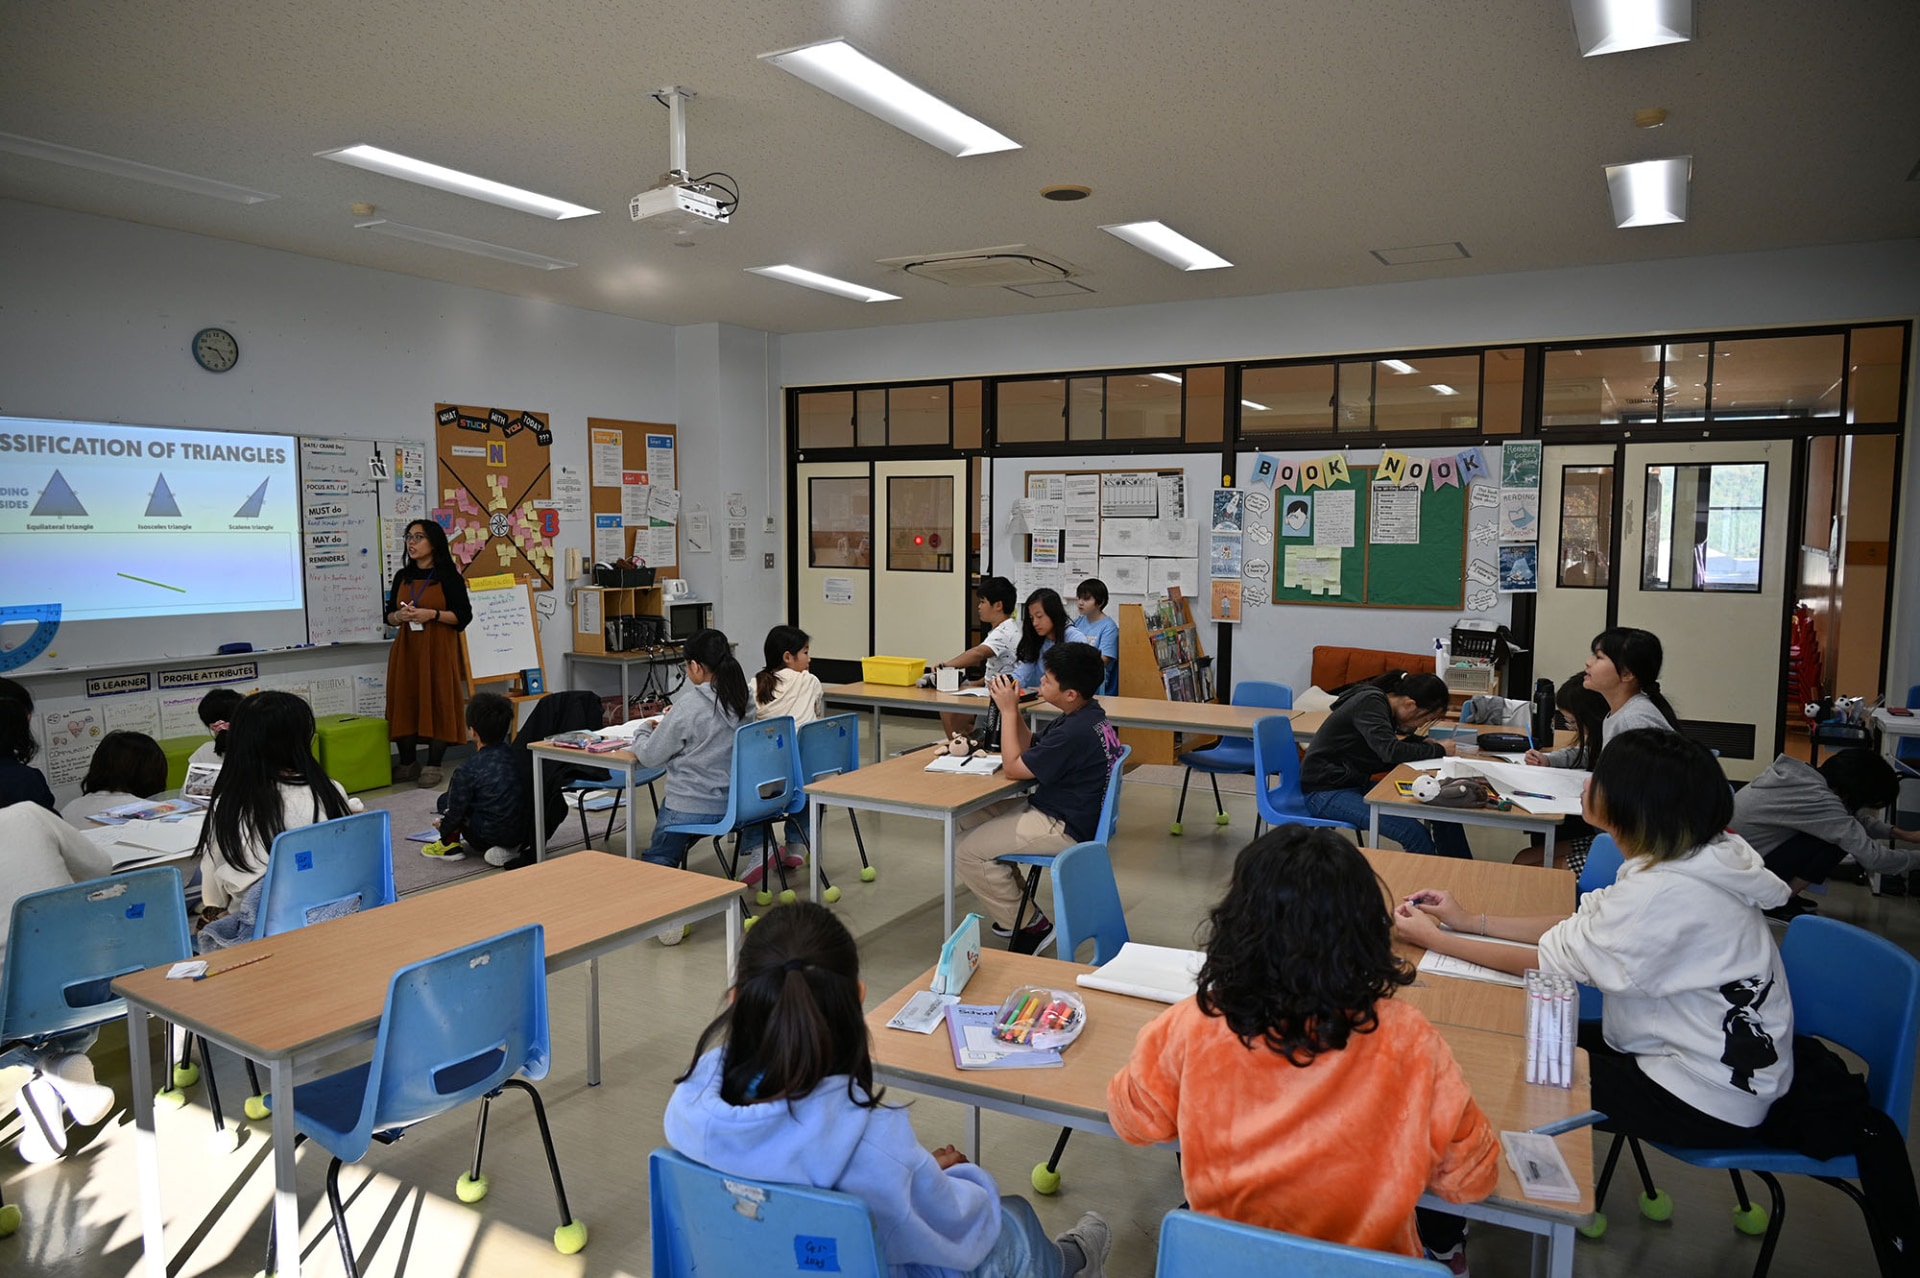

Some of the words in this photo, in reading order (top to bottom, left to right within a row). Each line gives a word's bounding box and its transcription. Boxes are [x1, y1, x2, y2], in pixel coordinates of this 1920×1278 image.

[439, 410, 456, 422] WHAT
[460, 418, 488, 430] STUCK
[490, 412, 506, 425] WITH
[505, 422, 521, 435] YOU
[523, 415, 542, 432] TODAY
[147, 440, 176, 459] OF
[180, 442, 286, 464] TRIANGLES
[490, 444, 504, 464] N
[370, 463, 387, 477] N
[1259, 460, 1342, 480] BOOK
[1385, 455, 1479, 478] NOOK
[0, 501, 29, 509] SIDES
[308, 507, 330, 516] MUST
[332, 505, 342, 514] do
[26, 523, 64, 531] Equilateral
[435, 513, 452, 529] W
[545, 514, 554, 532] E
[312, 536, 330, 544] MAY
[331, 535, 342, 543] do
[309, 555, 345, 564] REMINDERS
[91, 682, 100, 691] IB
[103, 678, 146, 690] LEARNER
[163, 671, 199, 683] PROFILE
[200, 666, 254, 680] ATTRIBUTES
